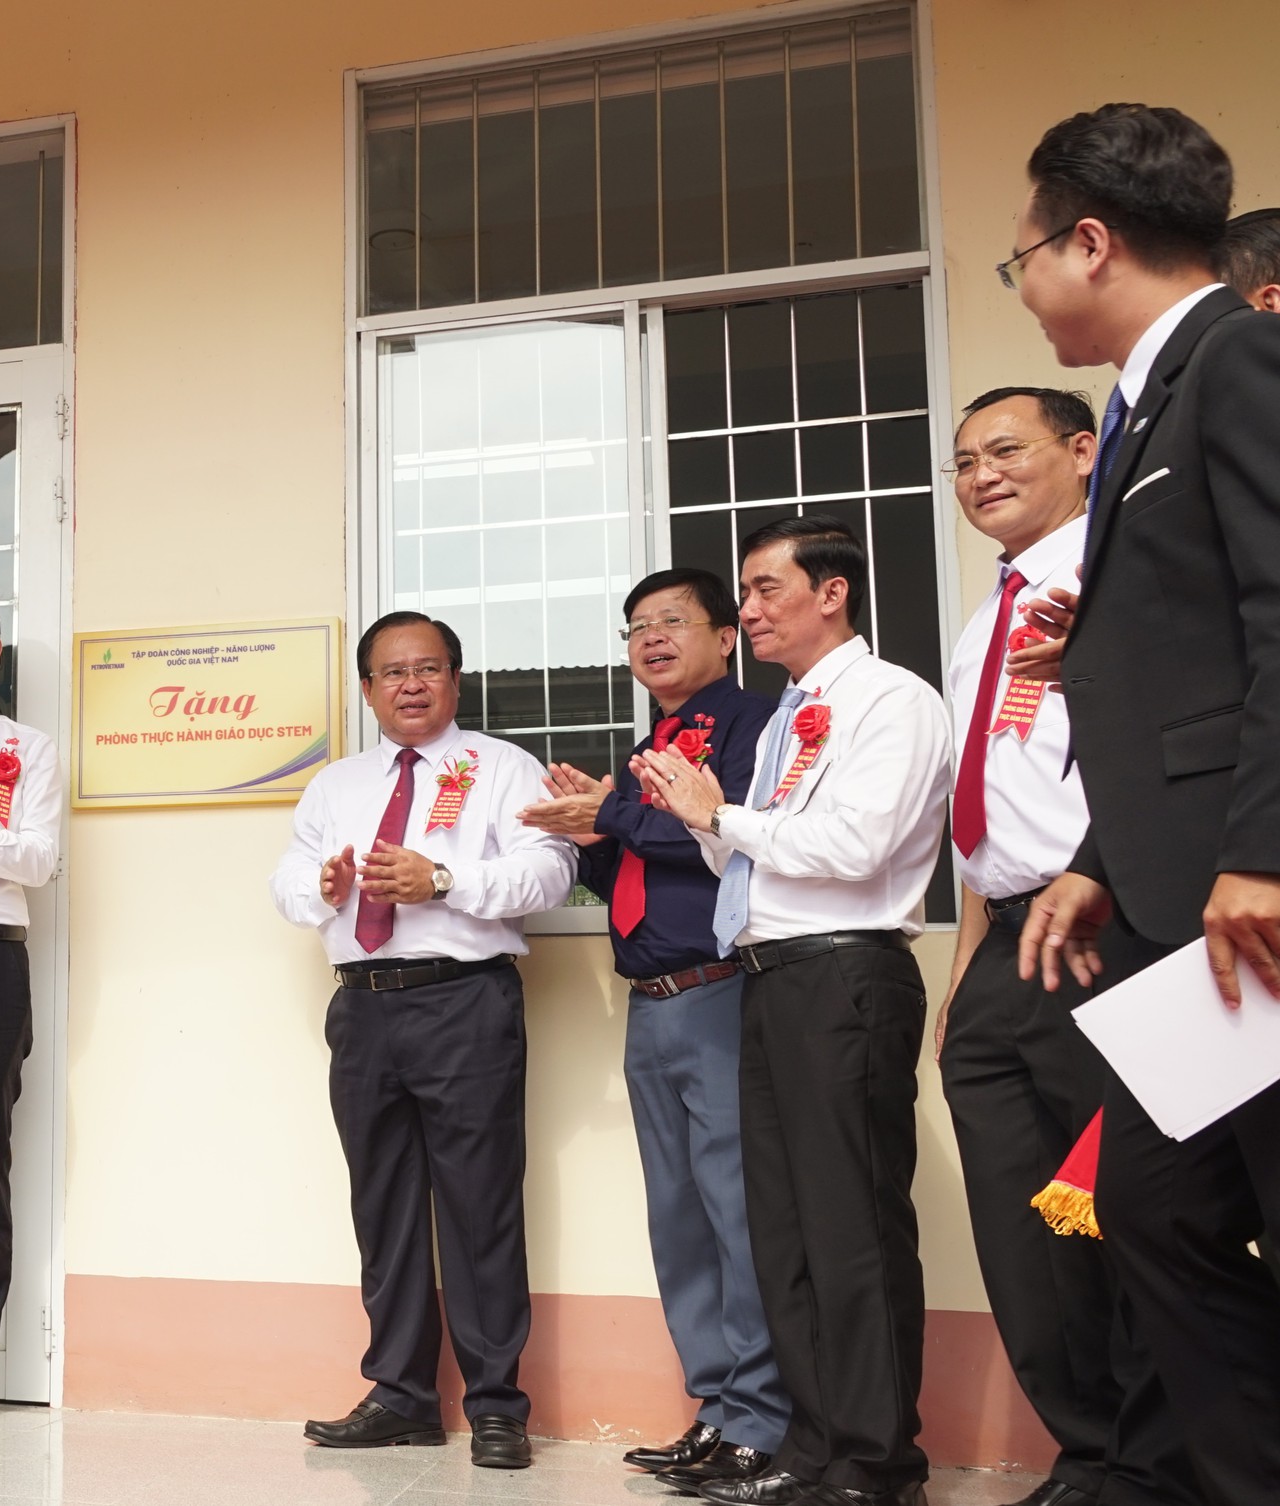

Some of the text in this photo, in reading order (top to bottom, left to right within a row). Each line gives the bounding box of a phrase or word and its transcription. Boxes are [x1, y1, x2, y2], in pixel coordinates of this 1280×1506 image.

[132, 651, 146, 659] TẬP
[148, 648, 169, 658] ĐOÀN
[170, 647, 190, 656] CÔNG
[192, 646, 219, 656] NGHIỆP
[226, 644, 248, 653] NĂNG
[250, 644, 275, 653] LƯỢNG
[167, 656, 187, 666] QUỐC
[202, 656, 219, 665] VIỆT
[149, 686, 259, 722] Tặng
[96, 725, 311, 746] PHÒNG THỰC HÀNH GIÁO DỤC STEM
